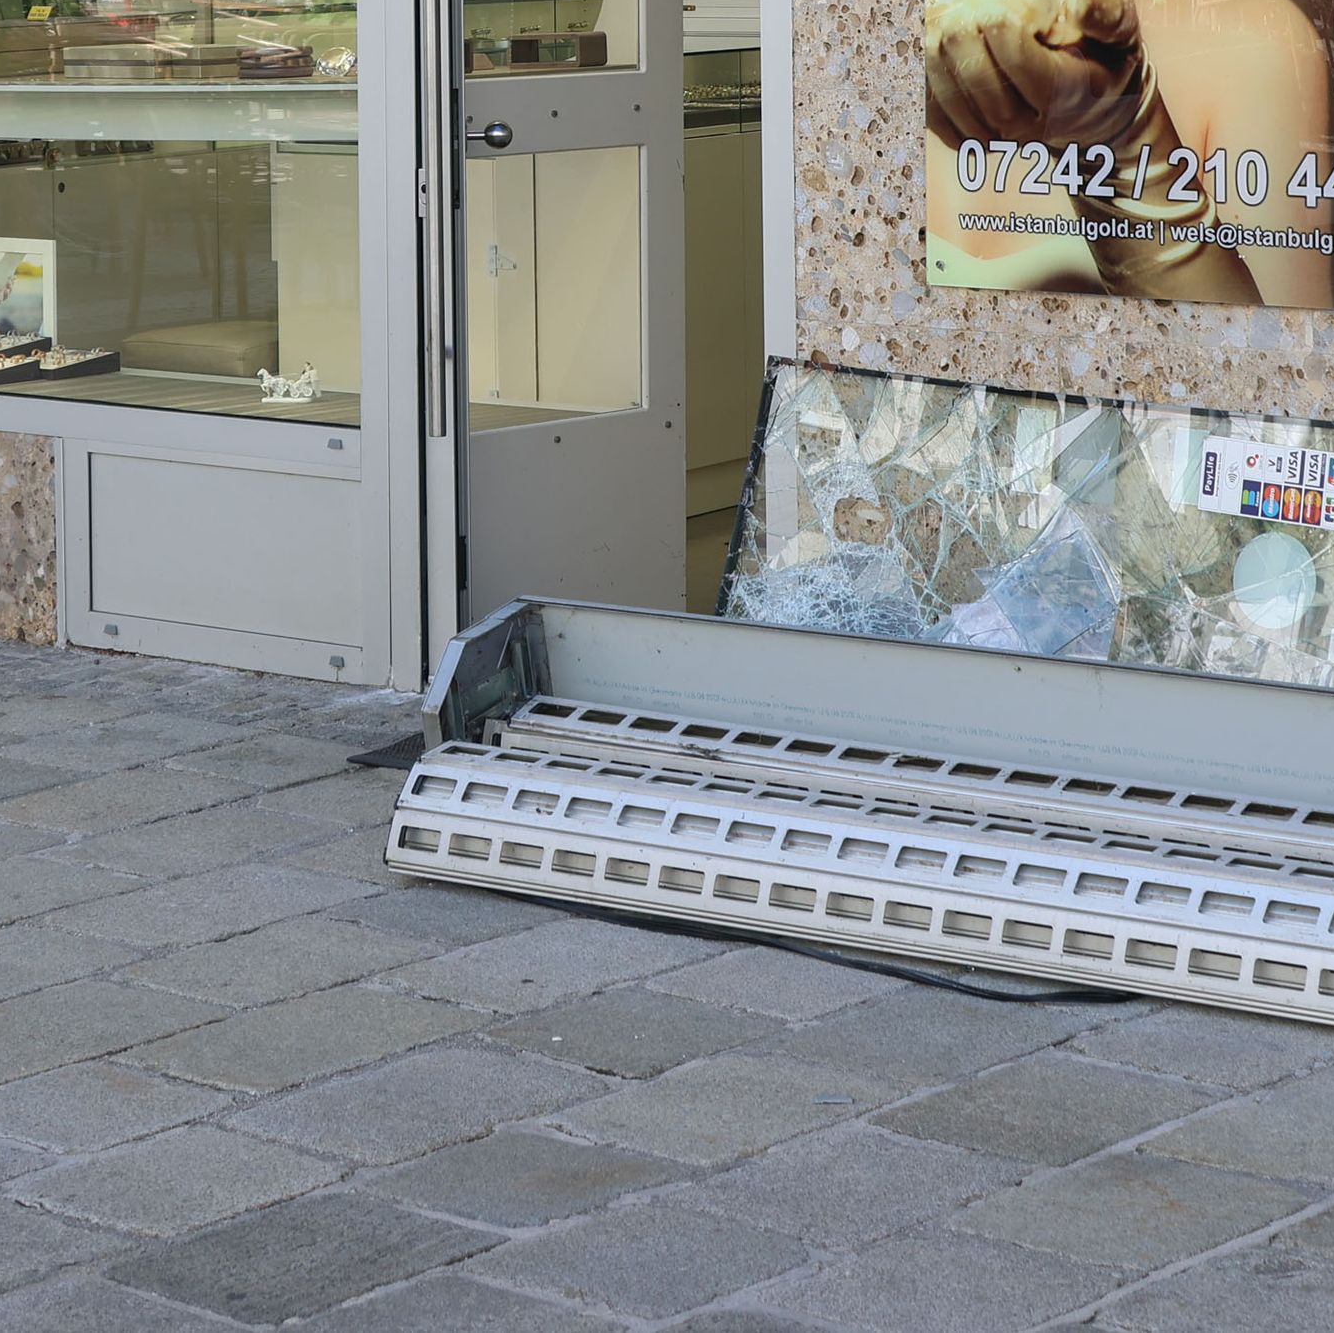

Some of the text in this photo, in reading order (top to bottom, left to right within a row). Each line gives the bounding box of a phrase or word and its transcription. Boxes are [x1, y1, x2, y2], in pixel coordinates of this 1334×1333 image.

[956, 138, 1116, 198] 07242
[1133, 145, 1151, 200] /
[1166, 146, 1269, 207] 210
[958, 212, 1154, 241] www.istanbulgold.at
[1205, 455, 1215, 492] PayLife
[1287, 451, 1299, 479] VISA
[1308, 454, 1320, 482] VISA
[1268, 487, 1276, 514] Maestro
